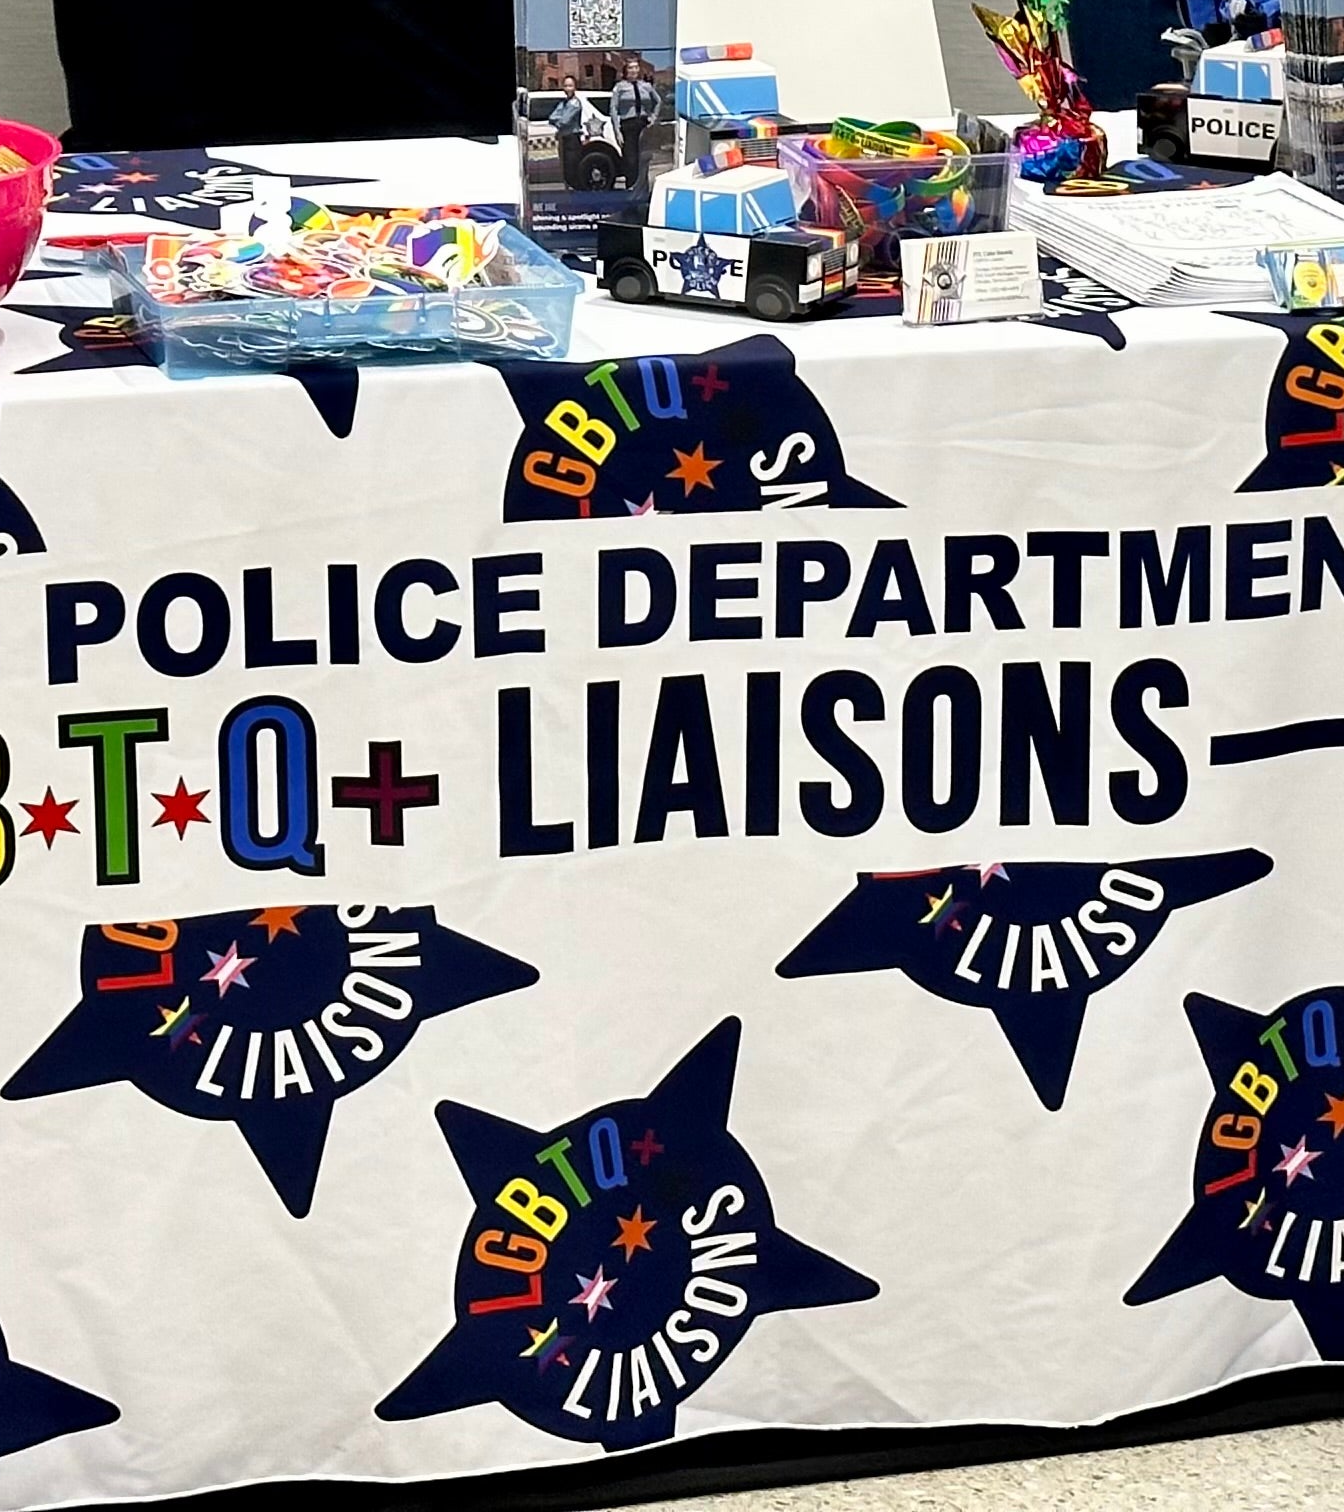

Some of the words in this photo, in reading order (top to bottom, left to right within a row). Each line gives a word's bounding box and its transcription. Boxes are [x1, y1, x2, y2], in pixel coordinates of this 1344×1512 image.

[1191, 116, 1277, 140] POLICE
[45, 552, 546, 686] POLICE
[498, 657, 1190, 838] LIAISONS
[469, 1117, 665, 1314] LGBTQ+
[562, 1183, 758, 1422] LIAISONS
